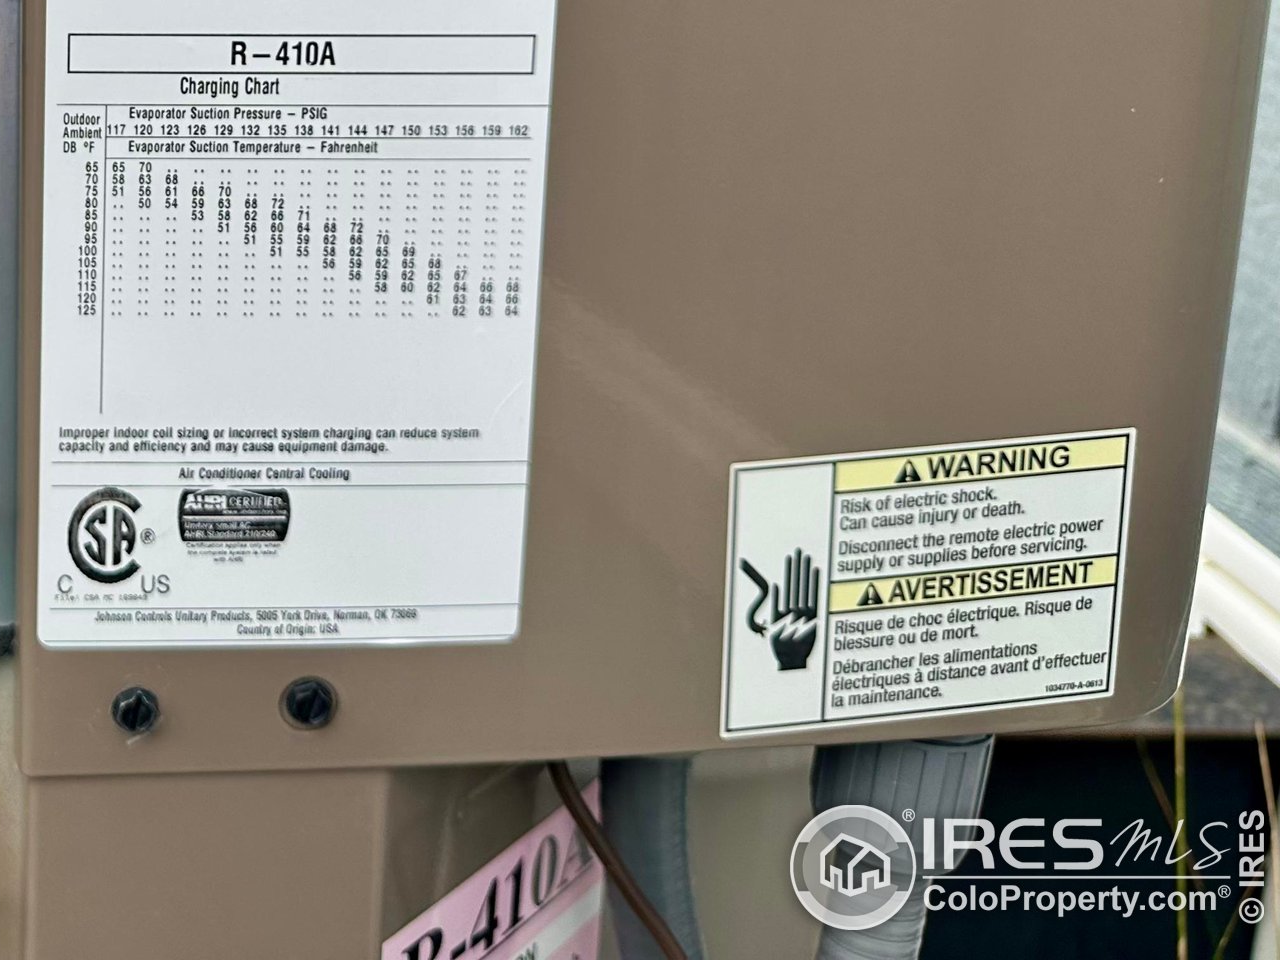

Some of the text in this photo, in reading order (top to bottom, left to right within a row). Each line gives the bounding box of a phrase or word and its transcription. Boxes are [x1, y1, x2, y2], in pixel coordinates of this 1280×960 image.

[180, 76, 279, 98] Charging Chart
[178, 466, 350, 481] Air Conditioner Central Cooling
[927, 445, 1069, 479] WARNING
[840, 486, 997, 513] Risk of electric shock.
[839, 500, 1025, 531] Can cause injury or death.
[838, 519, 1103, 555] Disconnect the remote electric power
[837, 535, 1087, 573] supply or supplies before servicing.
[140, 574, 170, 594] US
[888, 560, 1093, 602] AVERTISSEMENT
[834, 595, 1092, 635] Risque de choc électrique. Risque de
[833, 623, 978, 651] blessure ou de mort.
[832, 642, 1037, 674] Débrancher les alimentations
[831, 672, 910, 691] électriques
[913, 668, 923, 683] à
[927, 664, 986, 681] distance
[990, 657, 1028, 675] avant
[831, 685, 942, 707] la maintenance.
